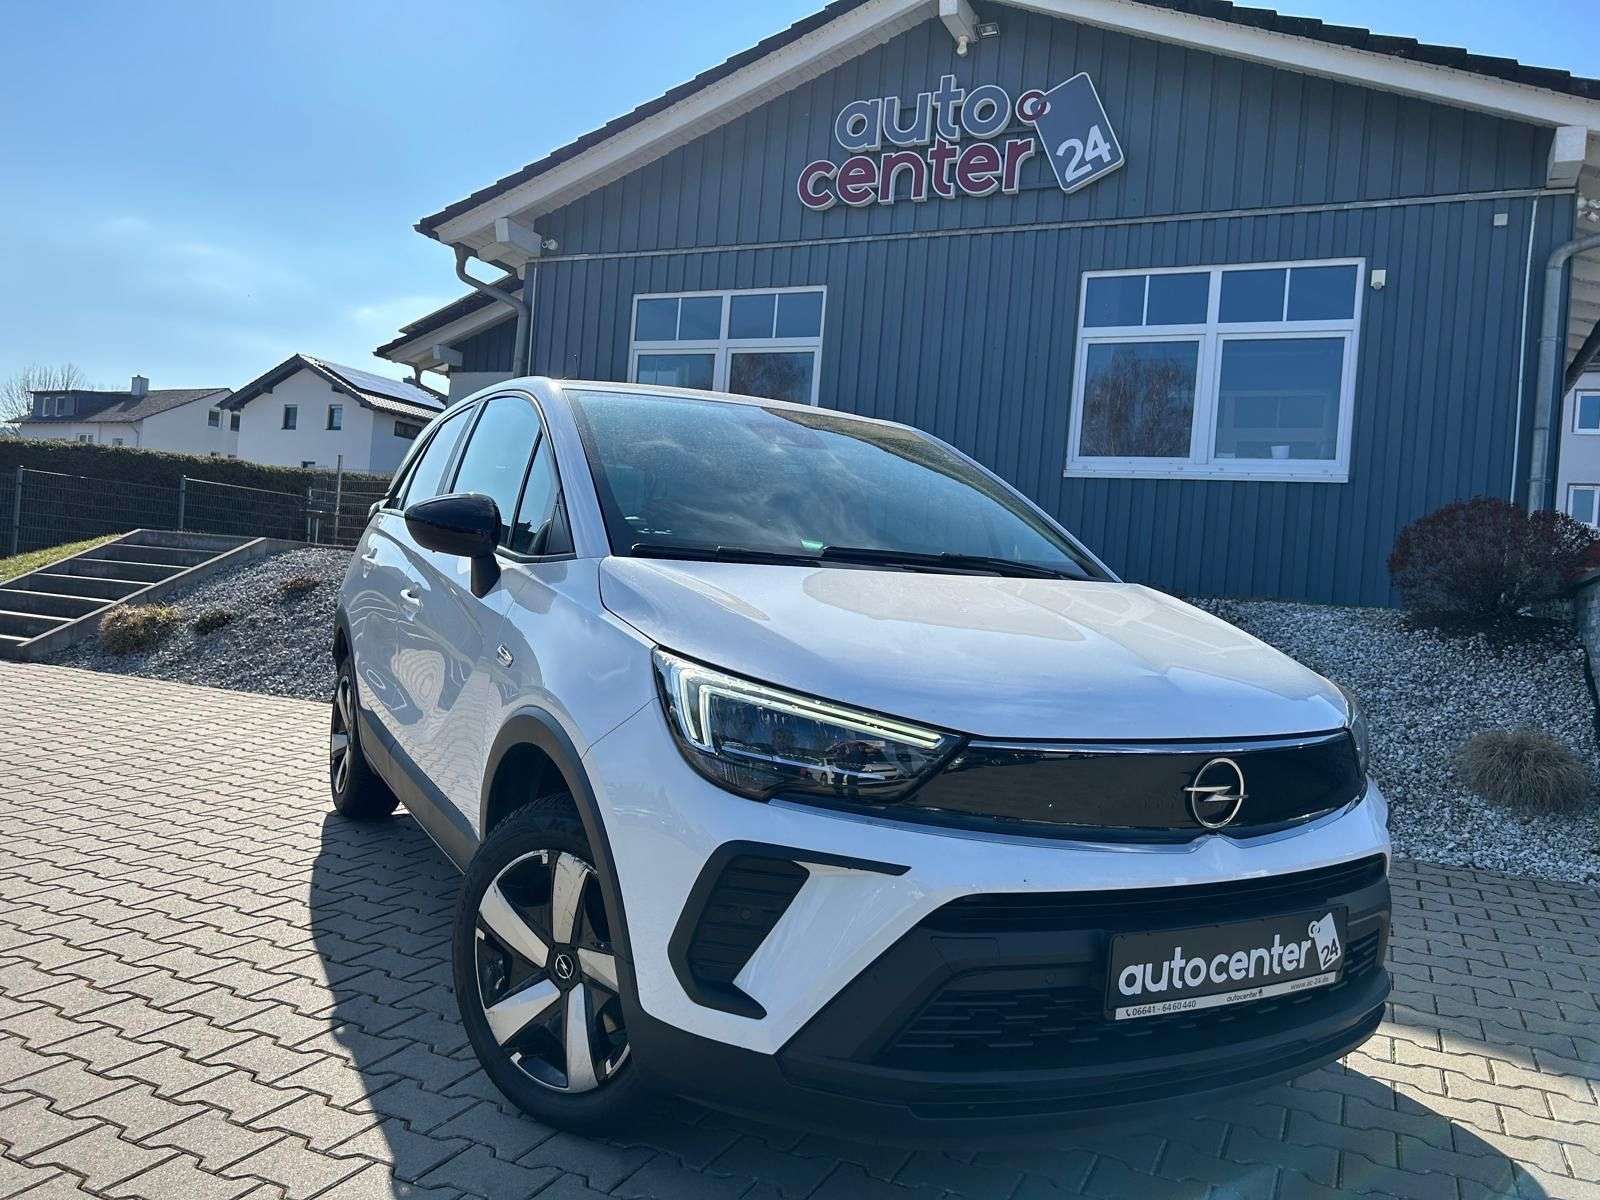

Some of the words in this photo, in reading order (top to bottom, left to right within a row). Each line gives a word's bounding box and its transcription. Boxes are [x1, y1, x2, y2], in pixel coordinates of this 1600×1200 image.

[834, 74, 1011, 152] auto
[797, 137, 1035, 211] center
[1056, 124, 1111, 183] 24
[1118, 934, 1311, 996] autocenter
[1321, 938, 1339, 967] 24
[1132, 1005, 1156, 1016] 06641
